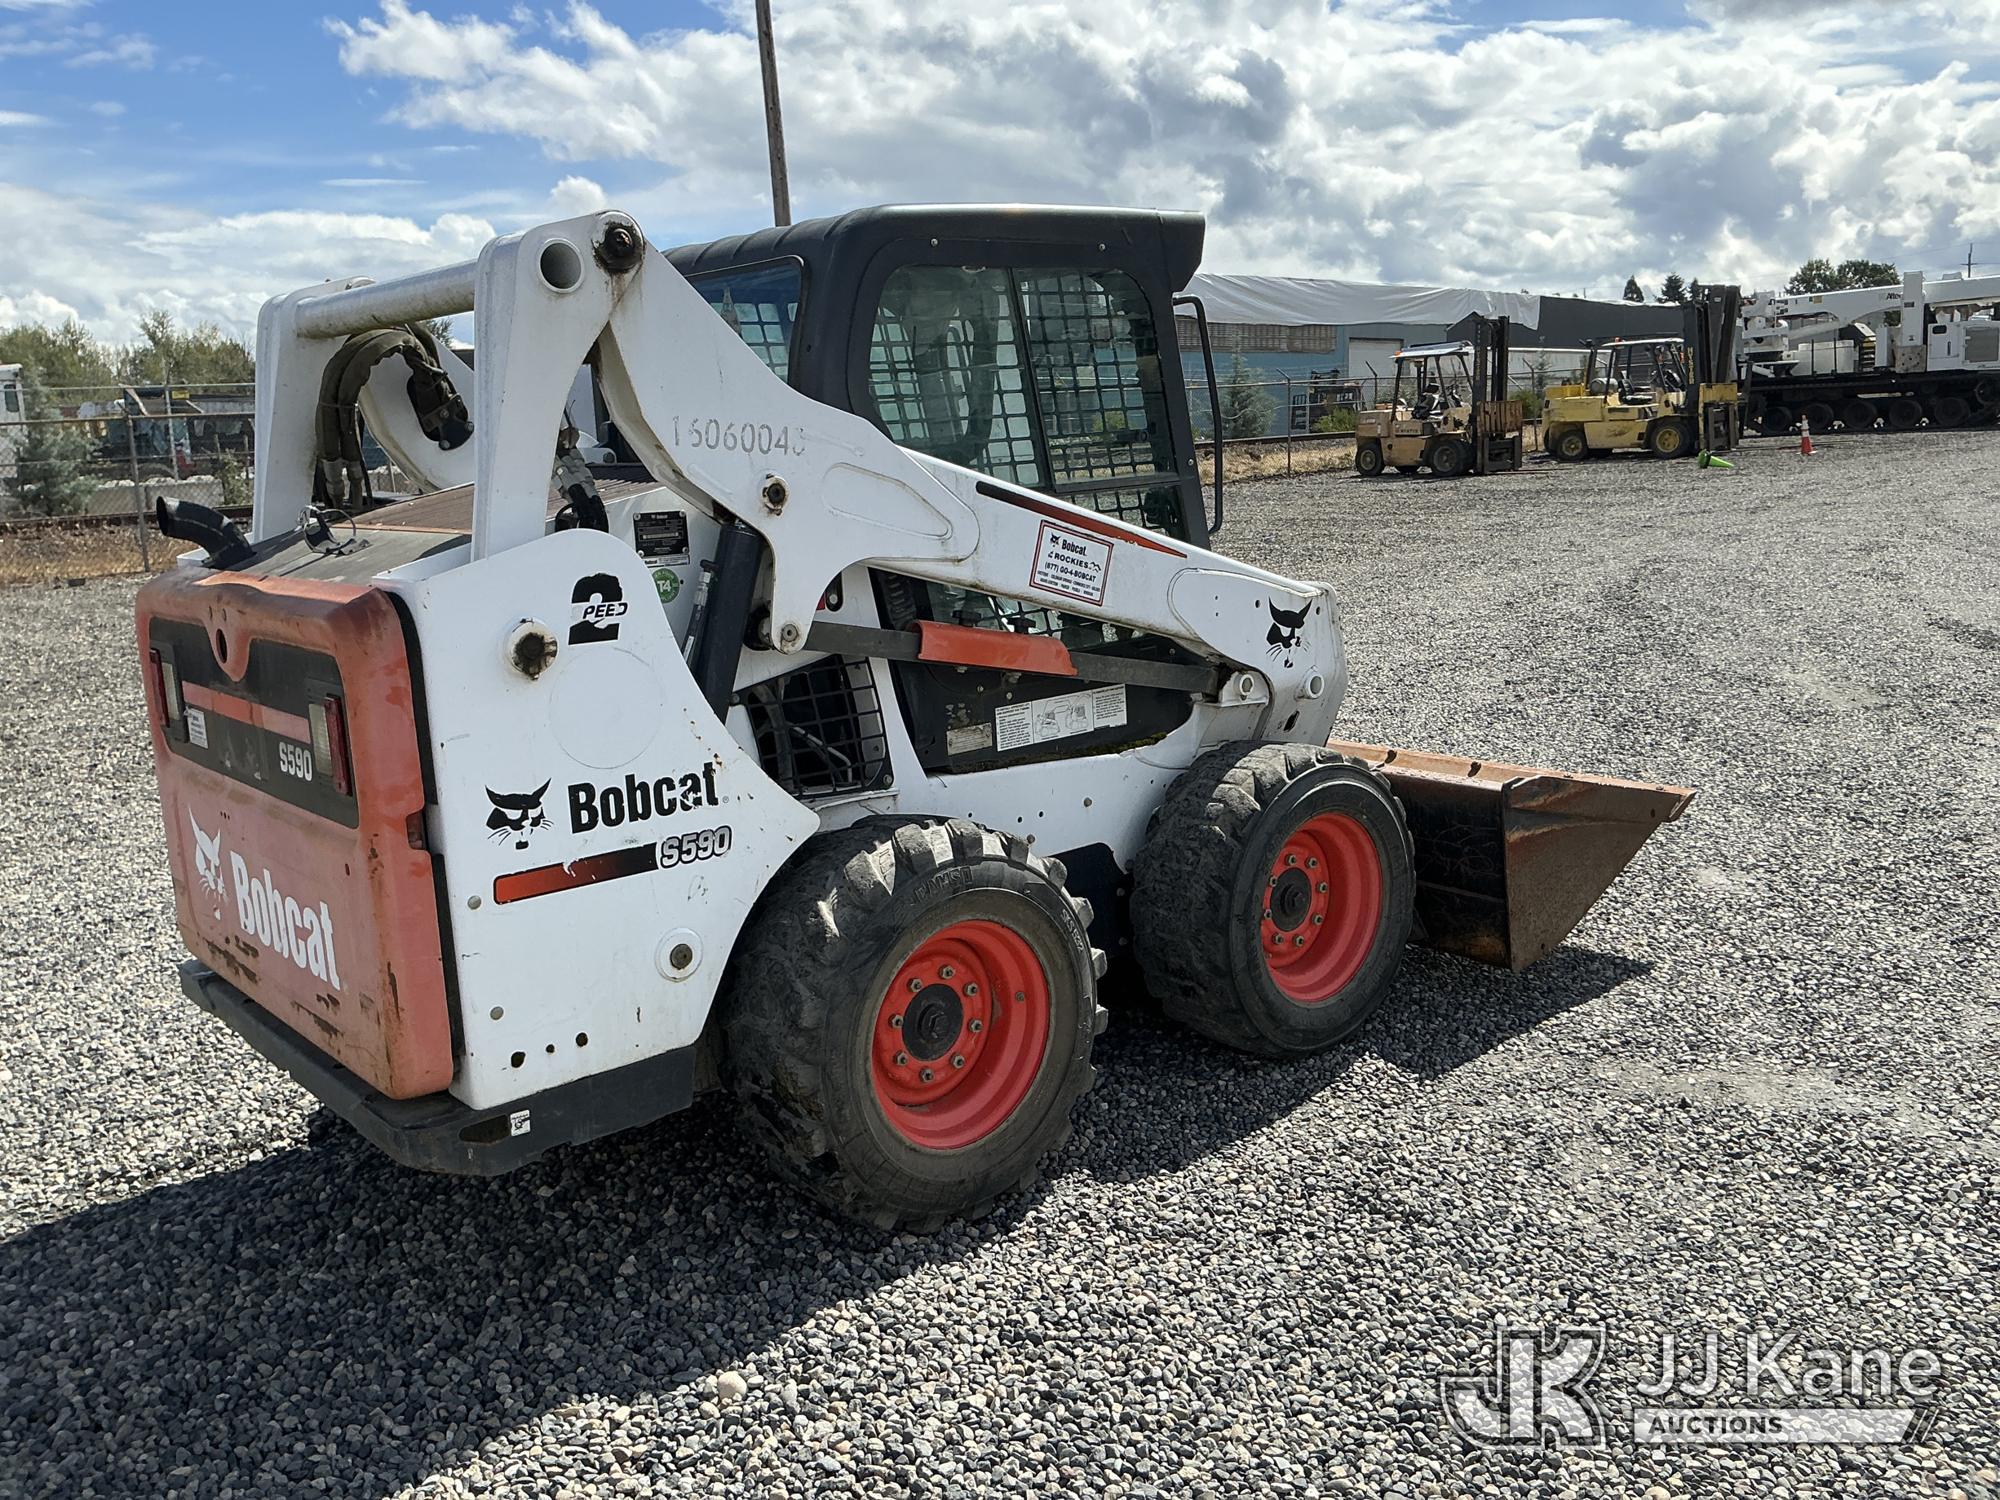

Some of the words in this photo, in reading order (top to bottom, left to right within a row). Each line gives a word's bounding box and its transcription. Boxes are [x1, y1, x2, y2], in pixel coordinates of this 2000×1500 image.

[1055, 552, 1089, 568] ROCKIES
[1061, 539, 1086, 556] Bobcat
[656, 580, 671, 592] T4
[572, 602, 628, 622] PEED
[278, 741, 313, 782] S590
[568, 761, 719, 834] Bobcat
[660, 826, 733, 869] S590
[229, 850, 340, 991] Bobcat
